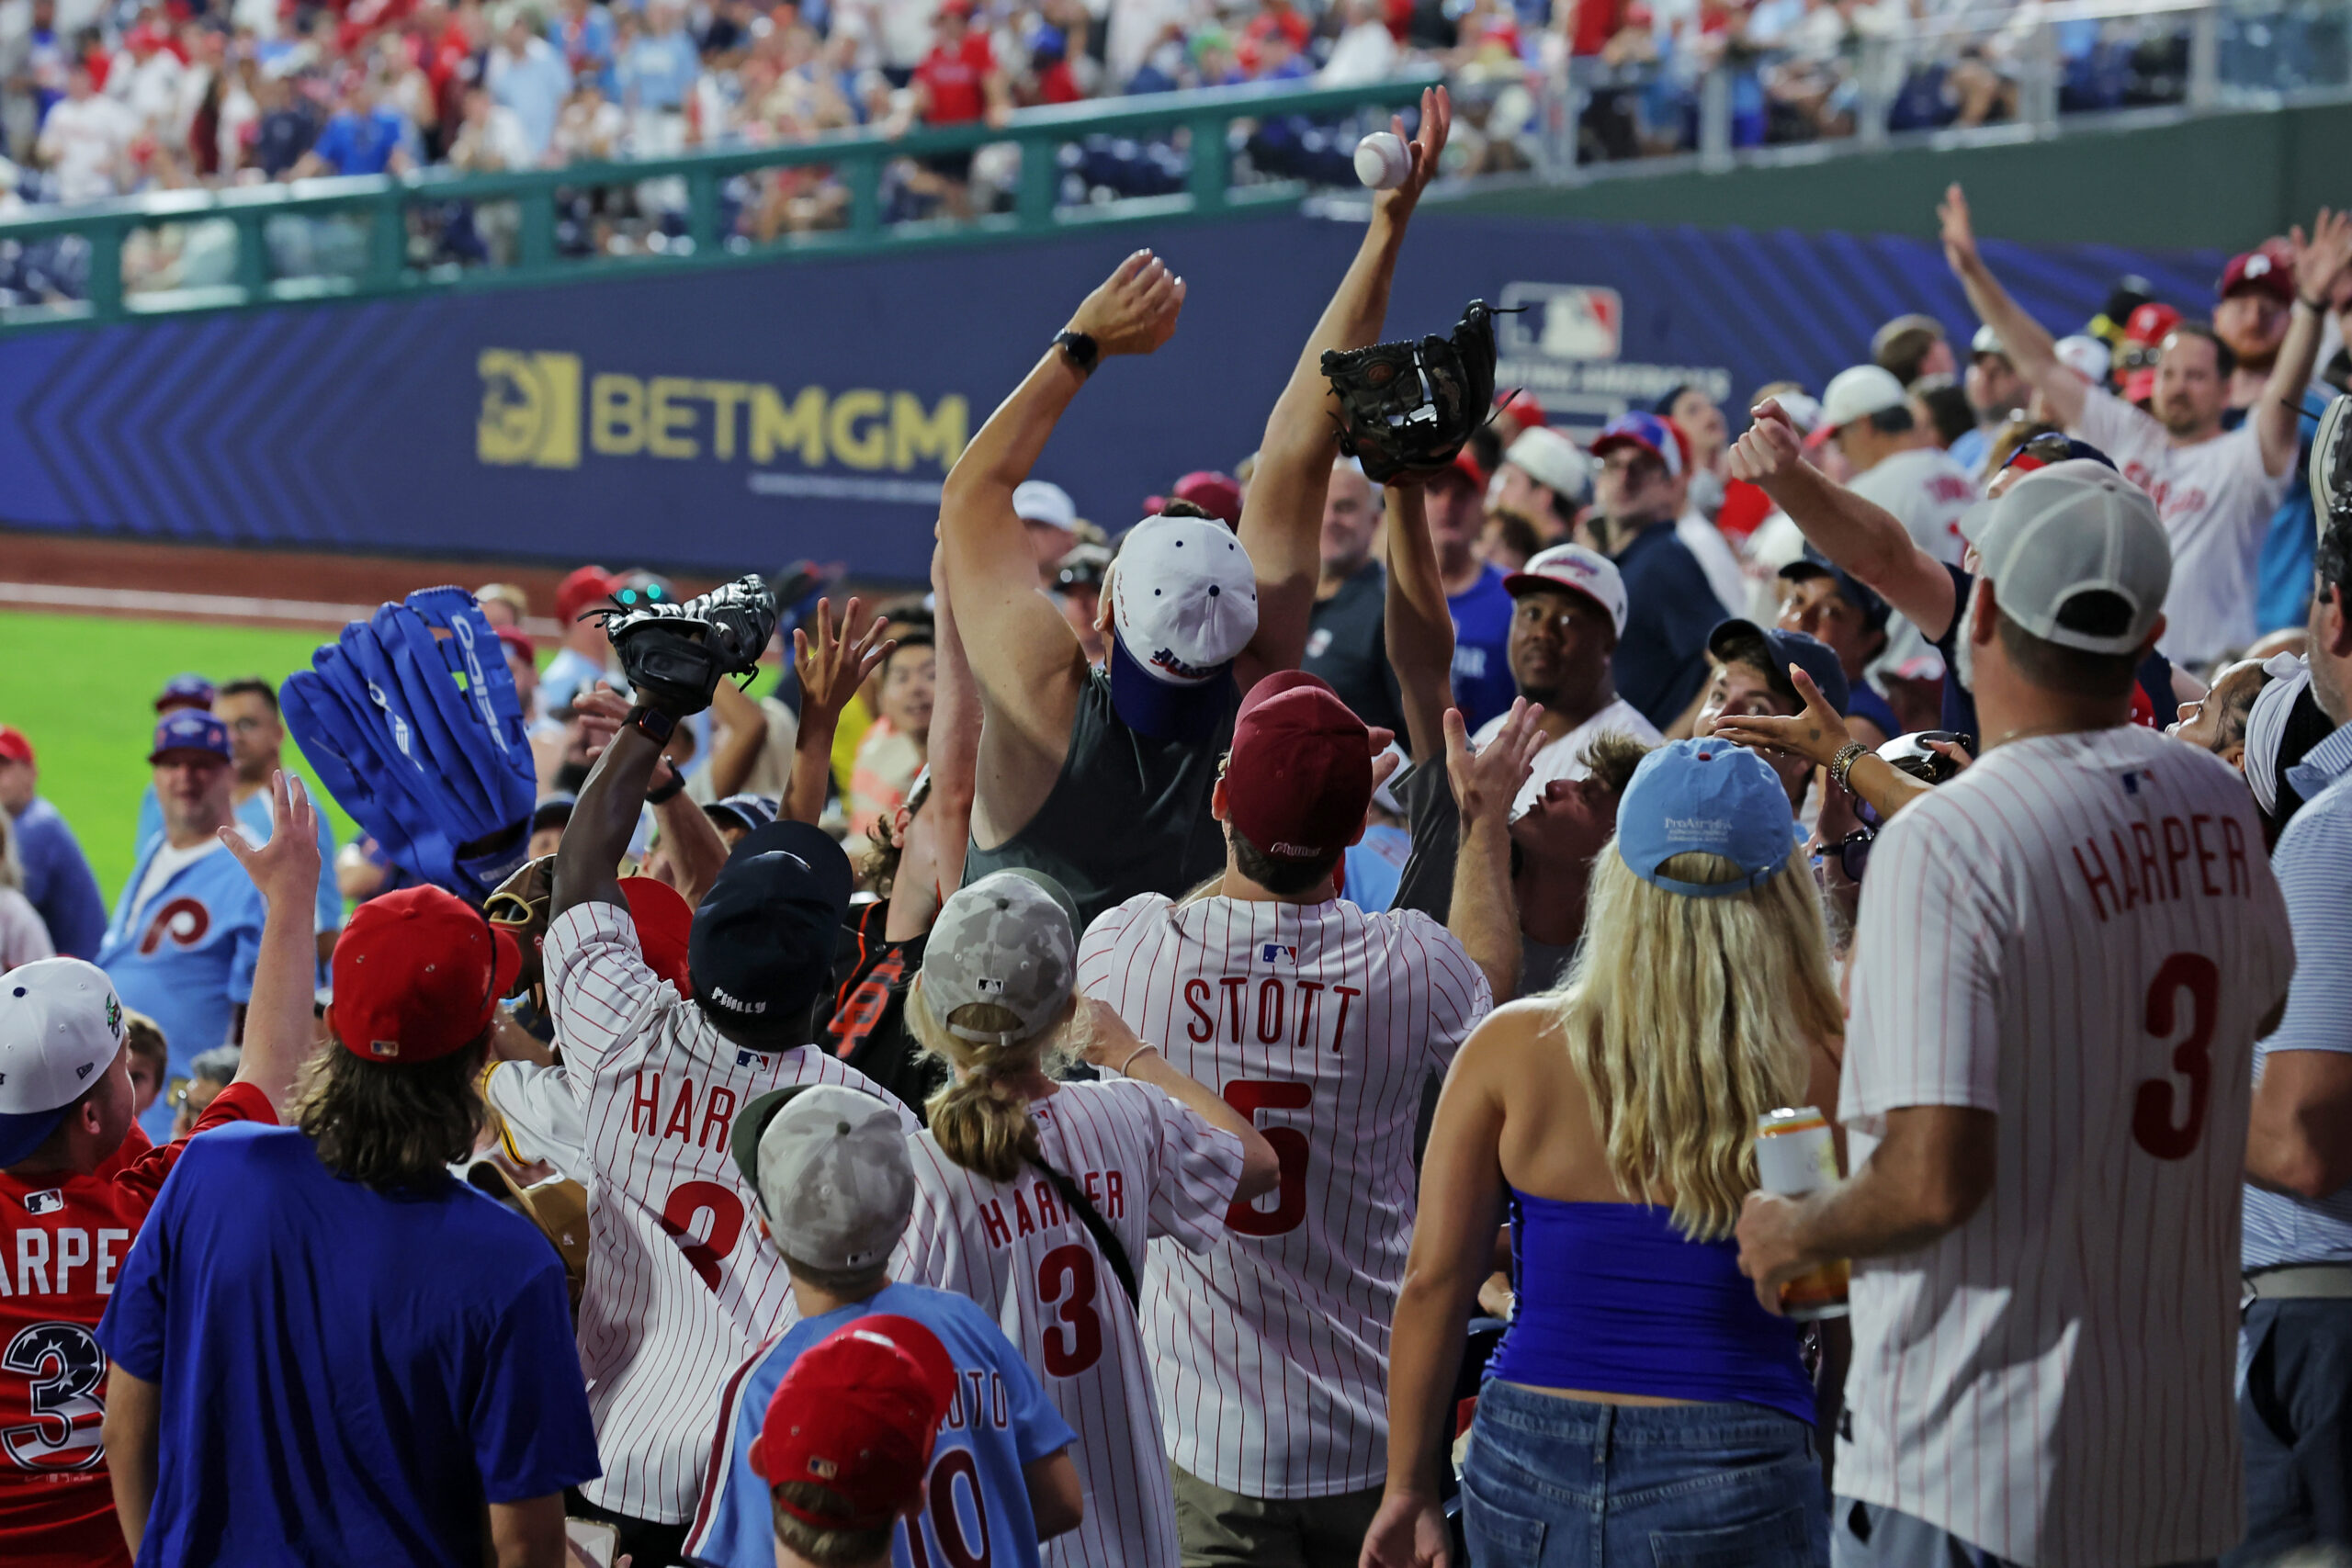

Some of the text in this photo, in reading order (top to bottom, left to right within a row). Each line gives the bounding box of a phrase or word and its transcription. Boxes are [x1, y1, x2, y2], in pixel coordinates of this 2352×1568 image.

[591, 373, 968, 473] BETMGM
[2072, 815, 2251, 922] HARPER
[1183, 977, 1362, 1053] STOTT
[2132, 953, 2219, 1160] 3
[1224, 1079, 1313, 1236] 5
[1038, 1244, 1103, 1378] 3
[1, 1320, 107, 1470] 3
[936, 1368, 1009, 1436] UTO
